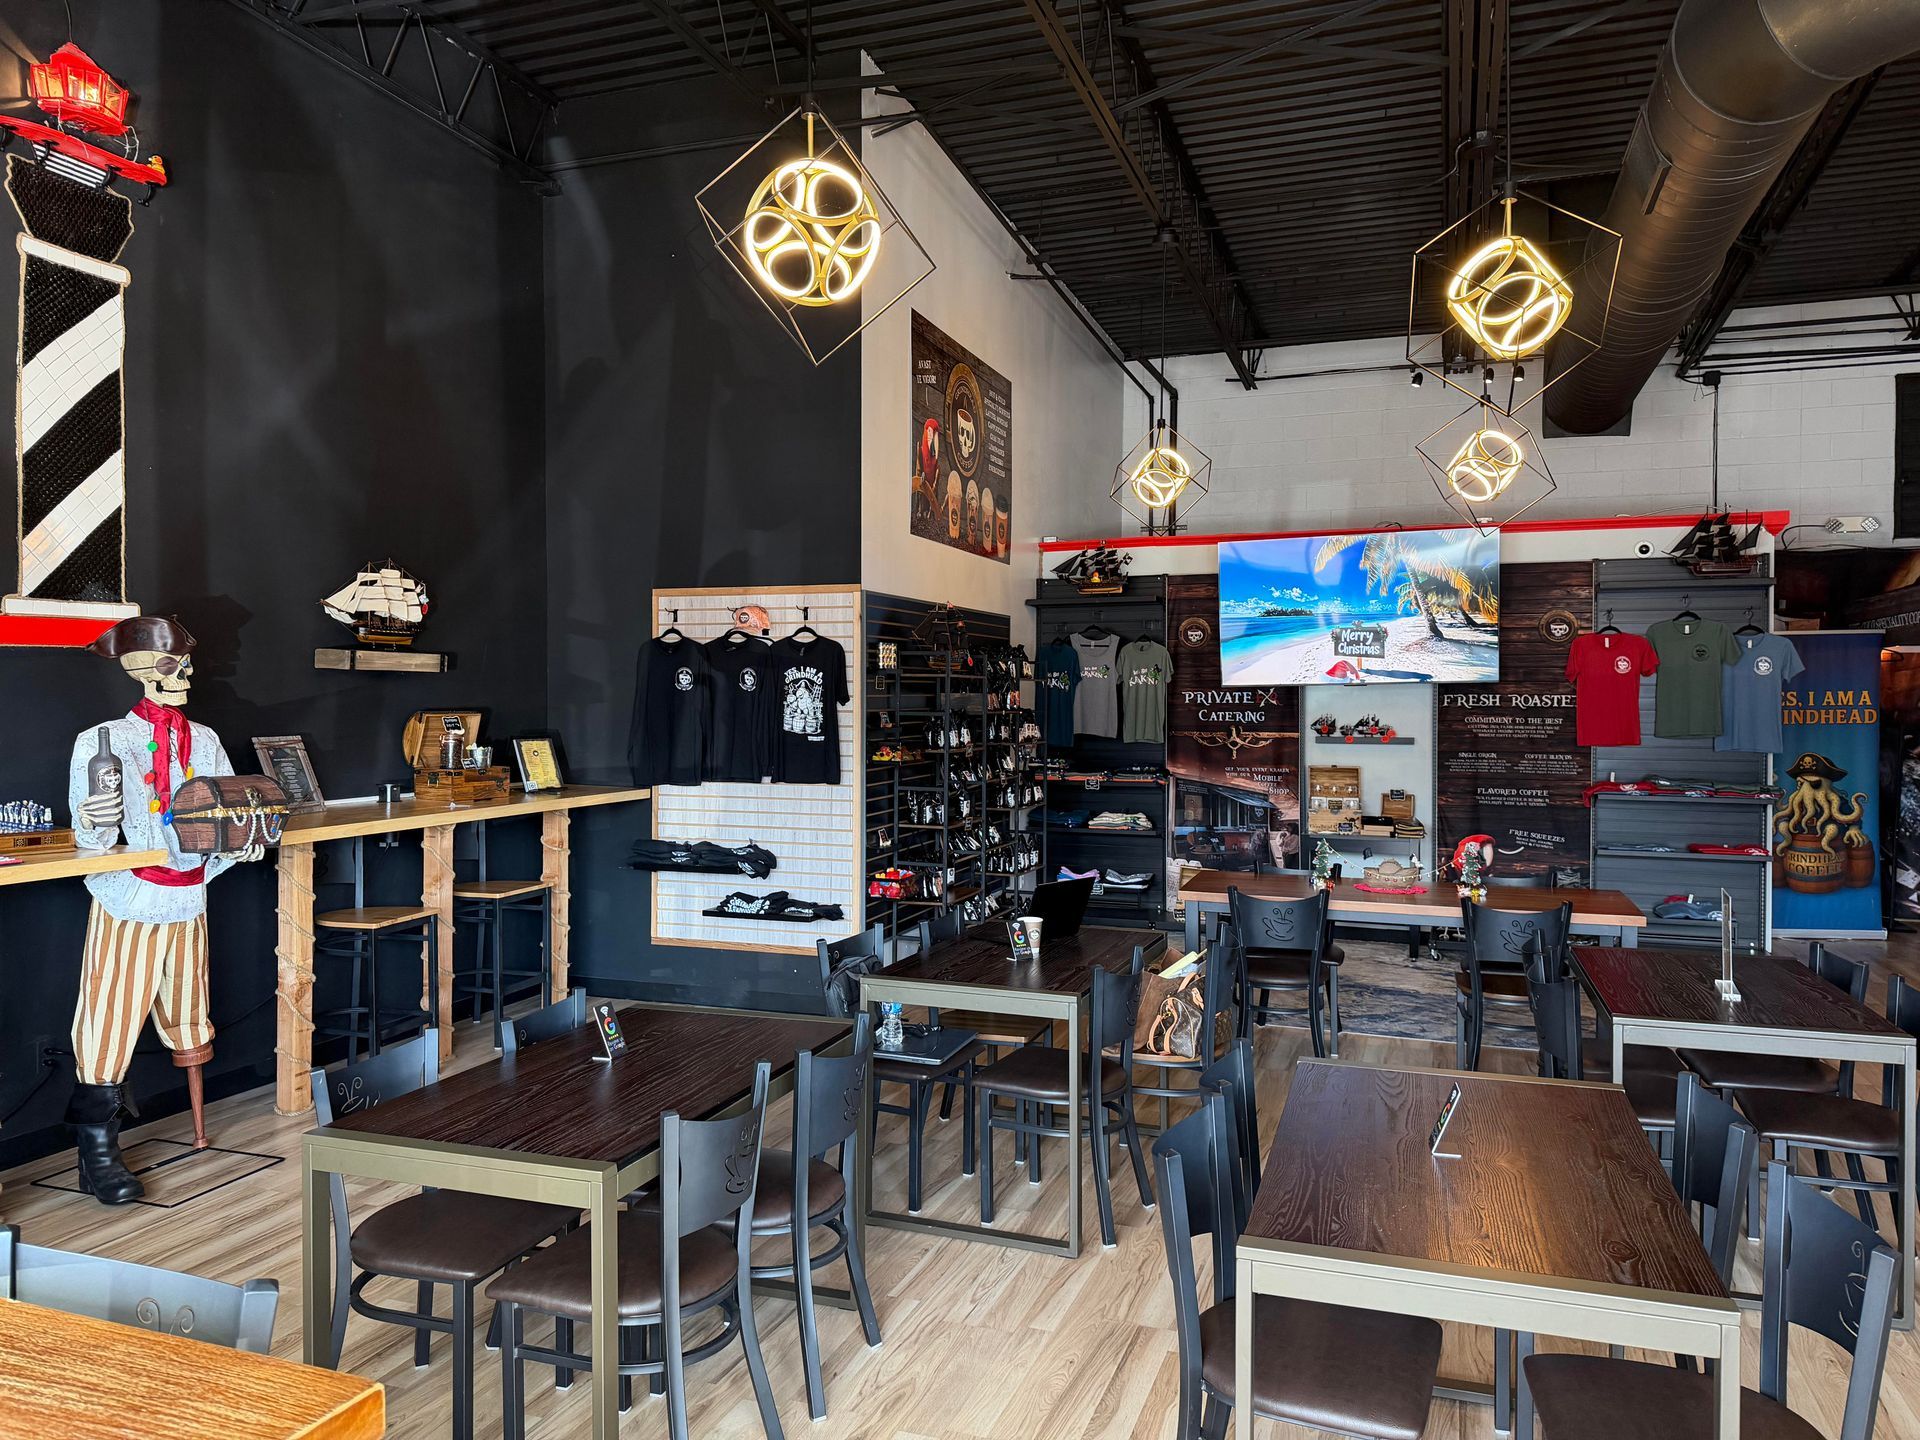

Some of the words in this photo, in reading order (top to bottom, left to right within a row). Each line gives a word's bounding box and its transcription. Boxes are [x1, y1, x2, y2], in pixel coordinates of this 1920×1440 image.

[1341, 629, 1373, 645] Merry
[1338, 642, 1381, 655] Christmas
[1182, 690, 1254, 706] PRIVATE
[1442, 694, 1501, 708] FRESH
[1508, 694, 1577, 709] ROASTE
[1808, 691, 1815, 706] I
[1822, 690, 1854, 706] AM
[1858, 690, 1872, 706] A
[1464, 716, 1513, 724] COMMITMENT
[1783, 709, 1878, 725] INDHEAD
[1477, 788, 1517, 796] FLAVORED
[1508, 828, 1529, 837] FREE
[1530, 832, 1565, 843] SQUEEZES
